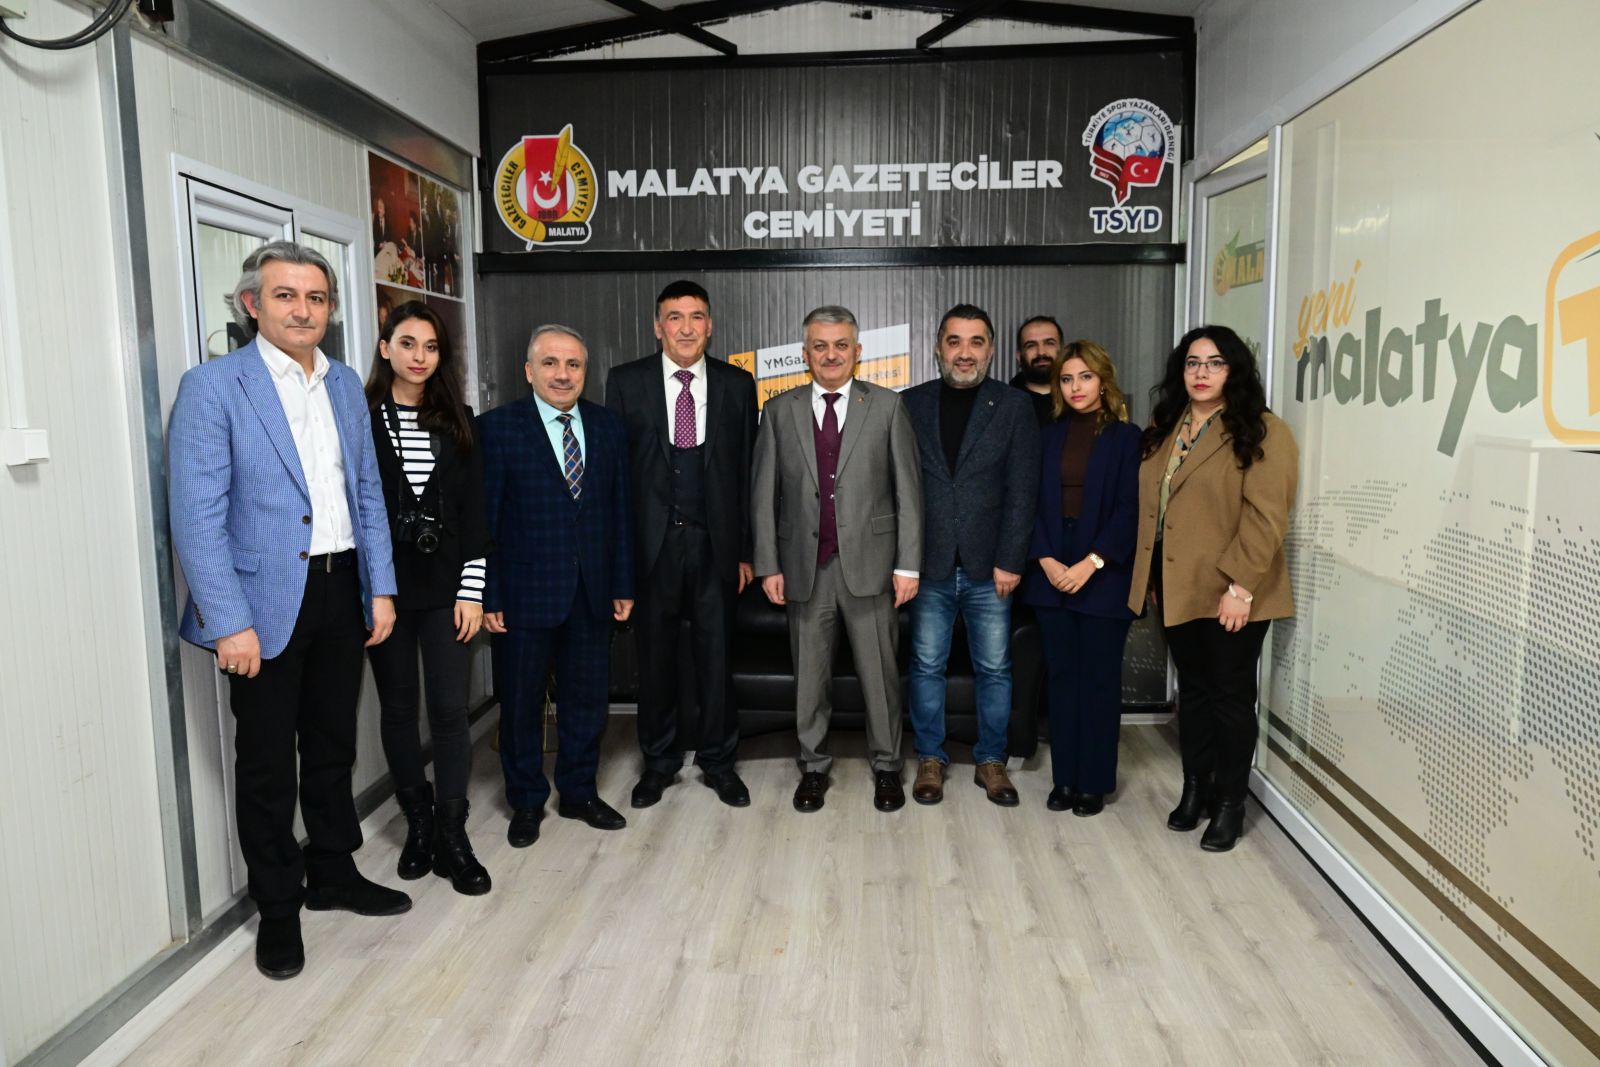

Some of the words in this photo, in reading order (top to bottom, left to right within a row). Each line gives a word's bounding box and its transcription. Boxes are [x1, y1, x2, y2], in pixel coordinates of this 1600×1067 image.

[1106, 101, 1127, 114] SPOR
[608, 166, 788, 197] MALATYA
[797, 154, 1063, 193] GAZETECİLER
[548, 227, 586, 237] MALATYA
[744, 201, 920, 238] CEMİYETİ
[1092, 209, 1159, 231] TSYD
[1292, 259, 1361, 359] yeni
[1296, 298, 1538, 457] malatya
